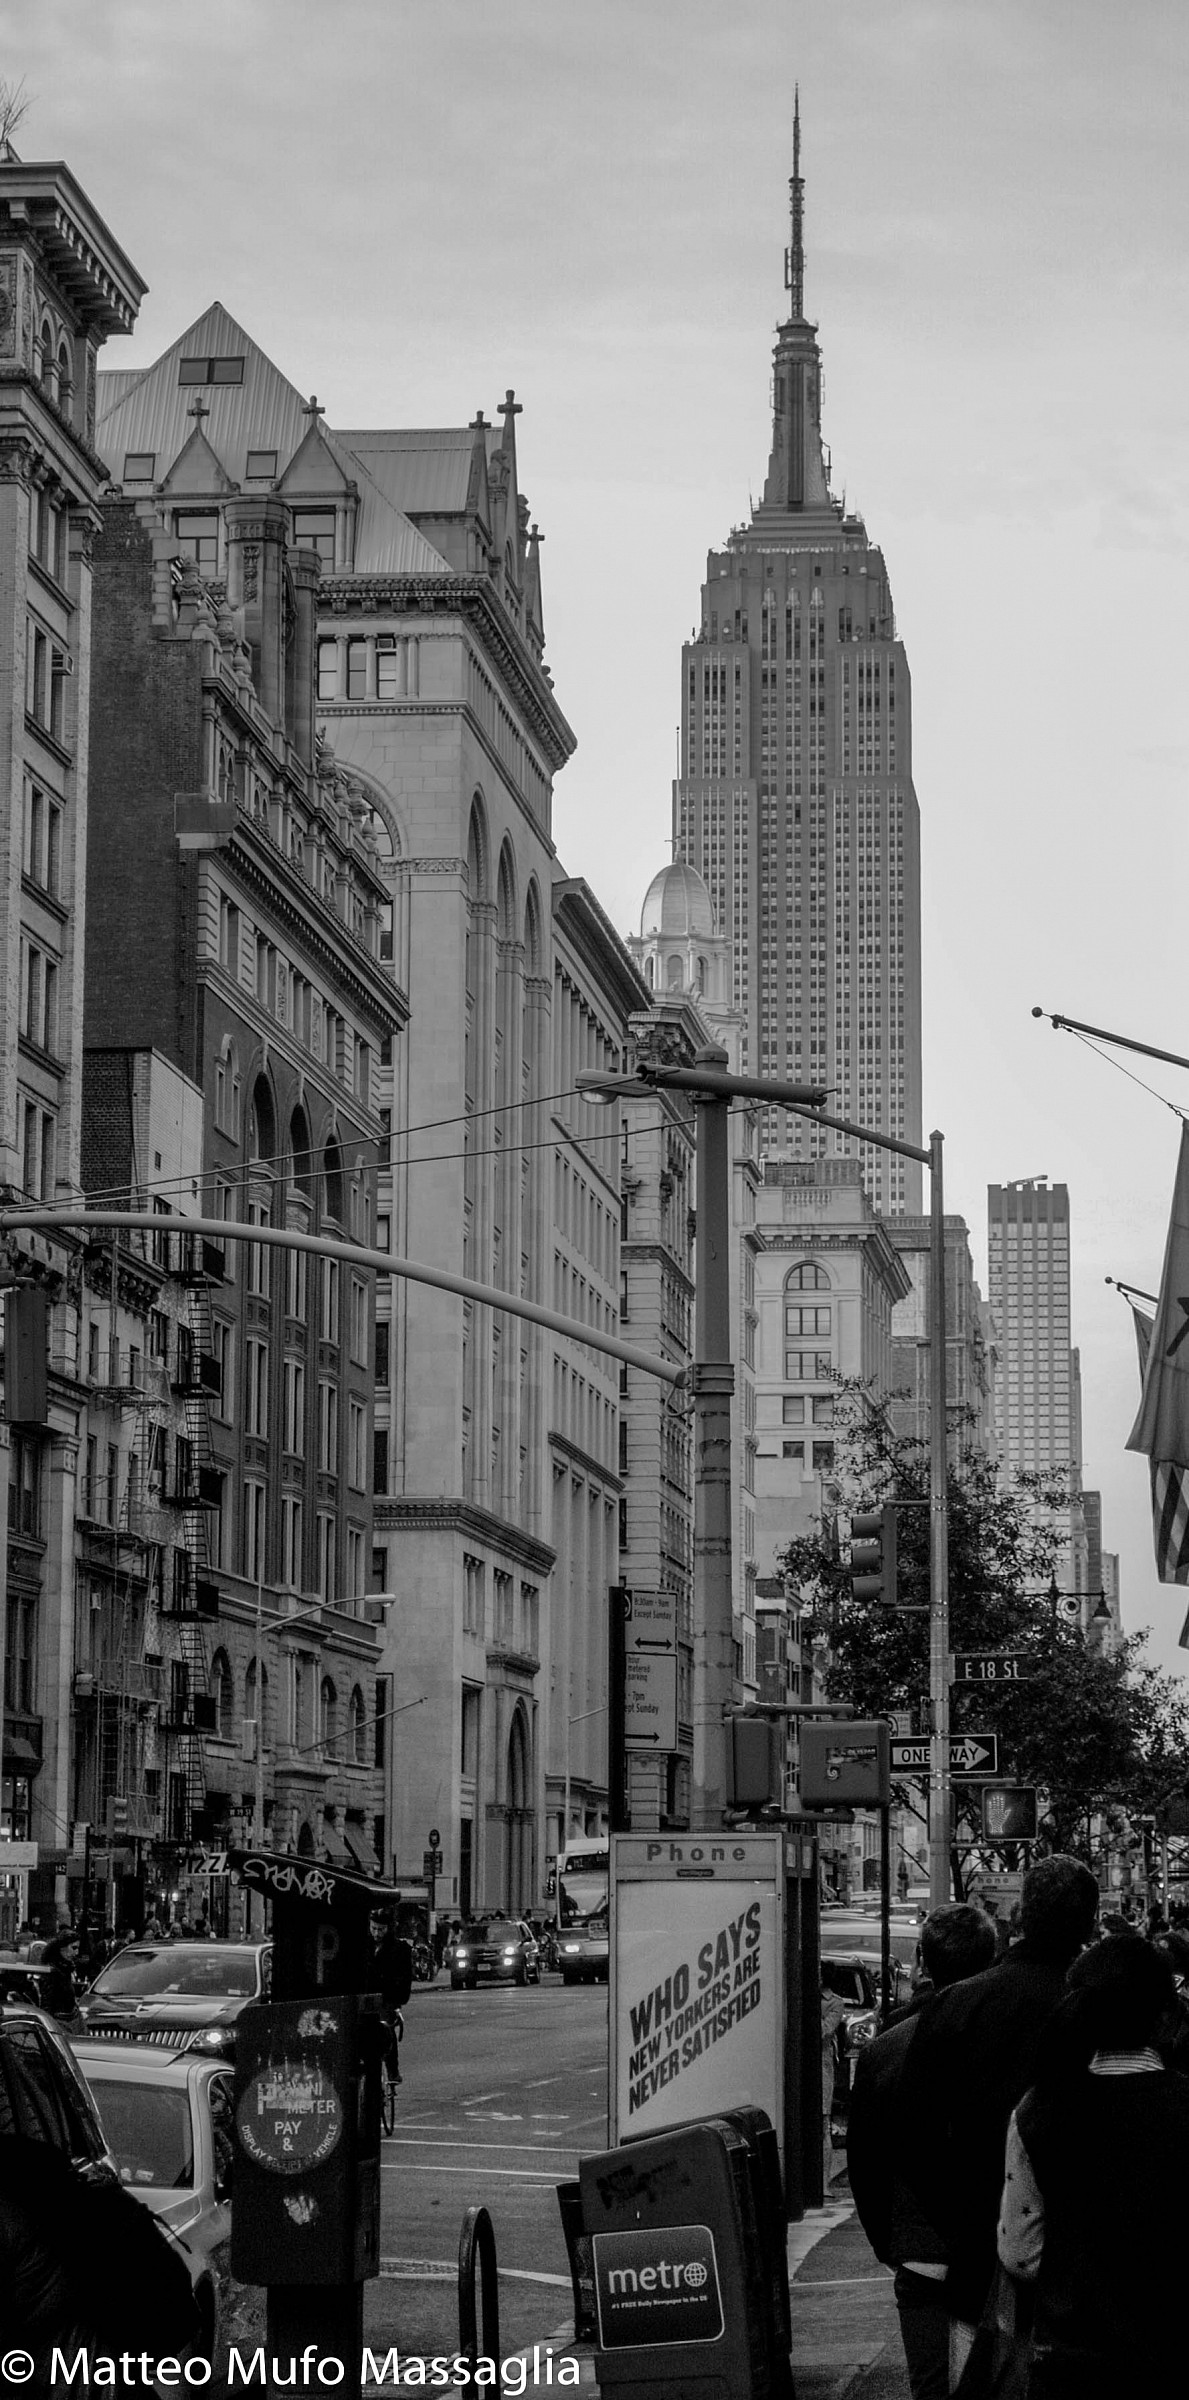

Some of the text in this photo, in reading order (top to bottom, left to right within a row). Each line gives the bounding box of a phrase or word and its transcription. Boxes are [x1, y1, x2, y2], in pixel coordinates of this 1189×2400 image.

[634, 1609, 672, 1621] Except Sunday
[628, 1673, 648, 1682] parking
[965, 1660, 1019, 1679] E 18 St
[636, 1703, 659, 1715] Sunday
[901, 1747, 979, 1763] ONE WAY
[646, 1843, 746, 1862] Phone
[977, 1876, 1009, 1884] hone
[316, 1924, 339, 1984] P
[629, 1902, 761, 2046] WHO SAYS
[629, 1947, 760, 2082] NEW YORKERS ARE
[629, 1978, 761, 2116] NEVER SATISFIED
[288, 2099, 336, 2114] METER
[274, 2120, 302, 2135] PAY
[241, 2124, 267, 2159] DISPLAY
[313, 2123, 338, 2158] VEHICLE
[282, 2137, 294, 2151] &
[608, 2259, 708, 2294] metro
[653, 2298, 682, 2306] Newspaper
